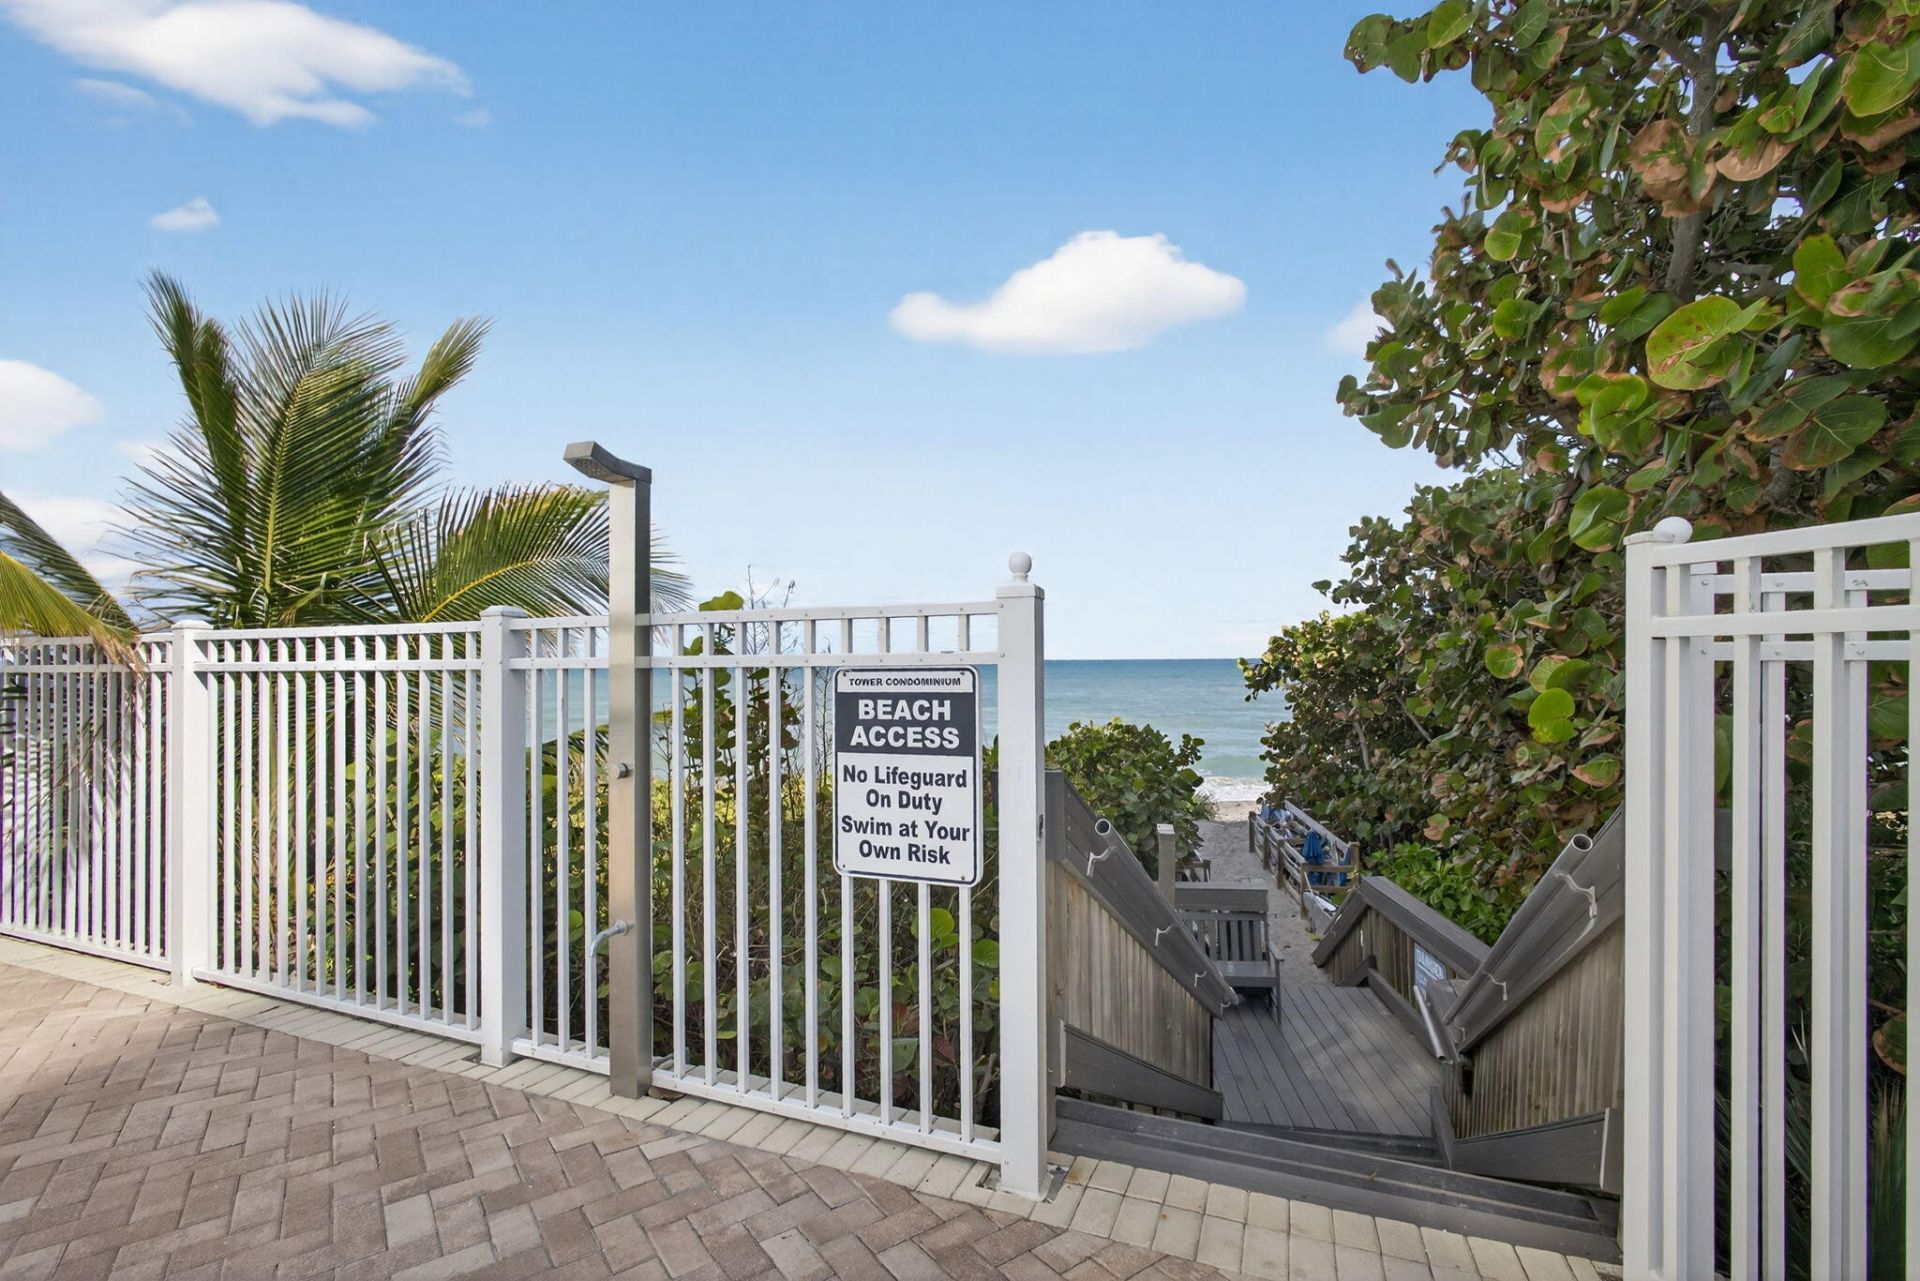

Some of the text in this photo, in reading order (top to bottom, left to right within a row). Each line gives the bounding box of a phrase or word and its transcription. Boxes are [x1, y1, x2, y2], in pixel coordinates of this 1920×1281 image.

[849, 678, 961, 687] TOWER CONDOMINIUM
[858, 699, 951, 721] BEACH
[850, 725, 960, 749] ACCESS
[843, 765, 967, 790] No Lifeguard
[866, 789, 943, 815] On Duty
[841, 815, 970, 841] Swim at Your
[859, 840, 951, 865] Own Risk
